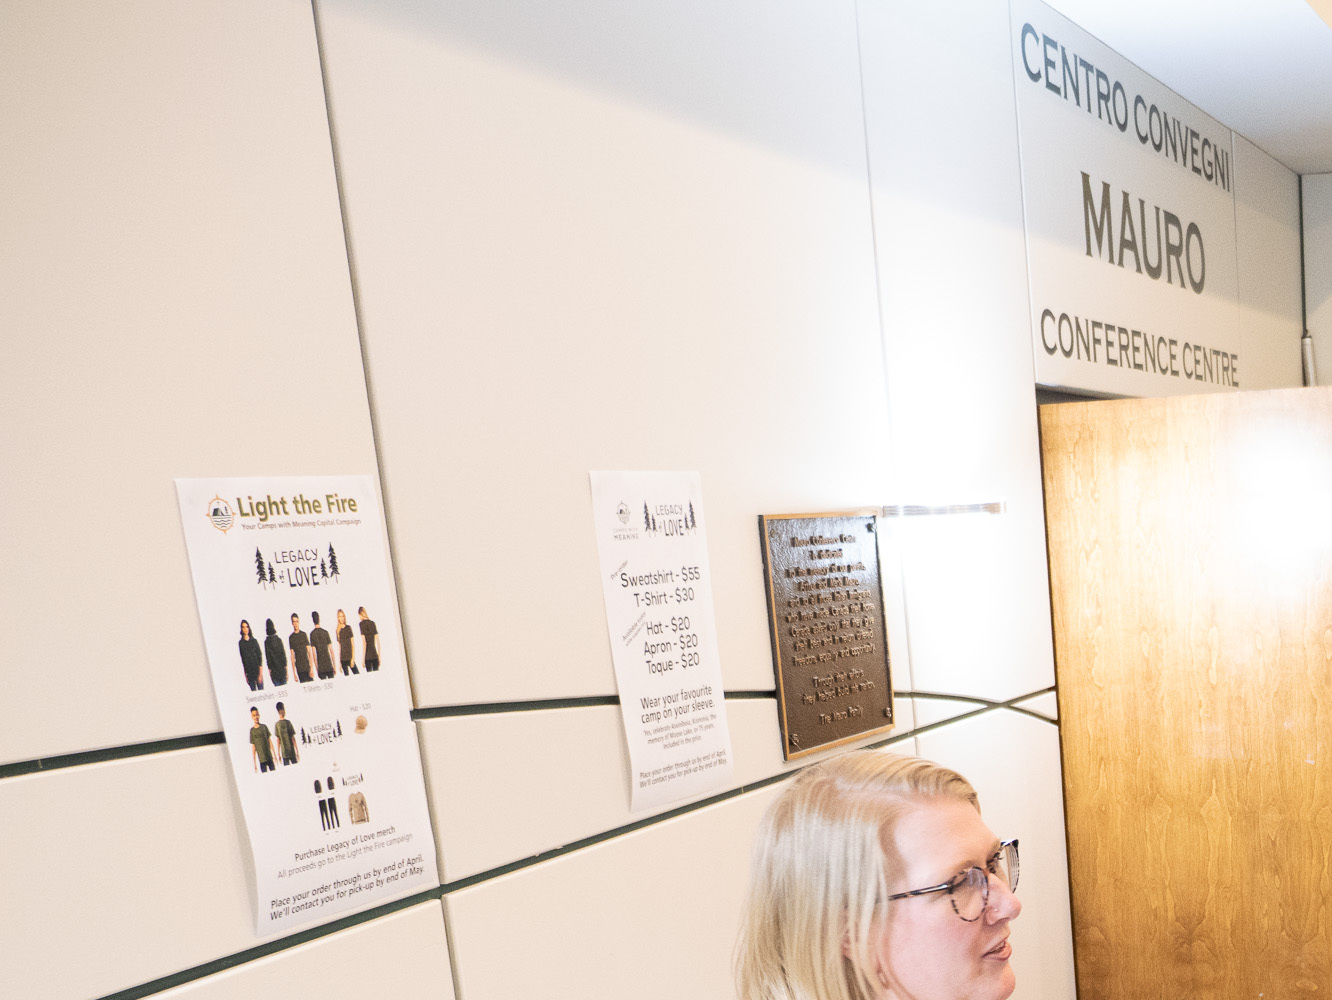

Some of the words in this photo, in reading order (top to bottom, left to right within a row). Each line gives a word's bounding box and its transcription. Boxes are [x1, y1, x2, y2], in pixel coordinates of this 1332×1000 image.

[1021, 22, 1128, 133] CENTRO
[1134, 94, 1231, 192] CONVEGNI
[1080, 170, 1206, 295] MAURO
[1041, 308, 1180, 377] CONFERENCE
[1182, 342, 1239, 387] CENTRE
[237, 495, 289, 522] Light
[293, 494, 322, 514] the
[326, 493, 358, 513] Fire
[655, 504, 683, 516] LEGACY
[241, 523, 256, 531] Your
[257, 522, 277, 530] Camps
[292, 520, 316, 529] Meaning
[317, 519, 335, 528] Capital
[336, 519, 361, 527] Campaign
[663, 519, 684, 536] LOVE
[274, 548, 318, 564] LEGACY
[287, 566, 319, 587] LOVE
[620, 570, 675, 588] Sweatshirt
[681, 565, 701, 583] $55
[634, 591, 668, 607] T-Shirt
[675, 587, 694, 604] $30
[646, 621, 663, 635] Hat
[671, 616, 690, 633] $20
[644, 641, 672, 658] Apron
[679, 634, 698, 651] $20
[646, 660, 673, 676] Toque
[681, 652, 699, 670] $20
[640, 697, 661, 710] Wear
[662, 693, 679, 708] your
[681, 684, 713, 699] favourite
[641, 711, 661, 724] camp
[663, 708, 672, 719] on
[674, 704, 690, 719] your
[692, 699, 715, 712] sleeve.
[310, 723, 332, 734] LEGACY
[316, 732, 333, 745] LOVE
[278, 870, 287, 879] All
[288, 861, 317, 877] proceeds
[318, 859, 326, 869] go
[327, 856, 334, 864] to
[335, 852, 346, 861] the
[347, 847, 362, 861] Light
[363, 844, 373, 853] the
[374, 840, 385, 850] Fire
[386, 832, 413, 846] campaign
[294, 849, 326, 862] Purchase
[327, 839, 350, 854] Legacy
[351, 835, 359, 845] of
[359, 832, 375, 843] Love
[376, 826, 396, 838] merch
[270, 905, 289, 920] We'll
[291, 899, 318, 914] contact
[320, 893, 334, 907] you
[336, 888, 346, 898] for
[349, 881, 374, 899] pick-up
[376, 876, 385, 888] by
[386, 871, 399, 883] end
[400, 868, 408, 878] of
[409, 865, 425, 878] May.
[271, 896, 290, 909] Place
[292, 890, 310, 905] your
[312, 883, 331, 897] order
[333, 873, 361, 889] through
[363, 871, 371, 880] us
[373, 867, 381, 877] by
[383, 861, 396, 873] end
[397, 860, 405, 869] of
[406, 854, 424, 867] April.
